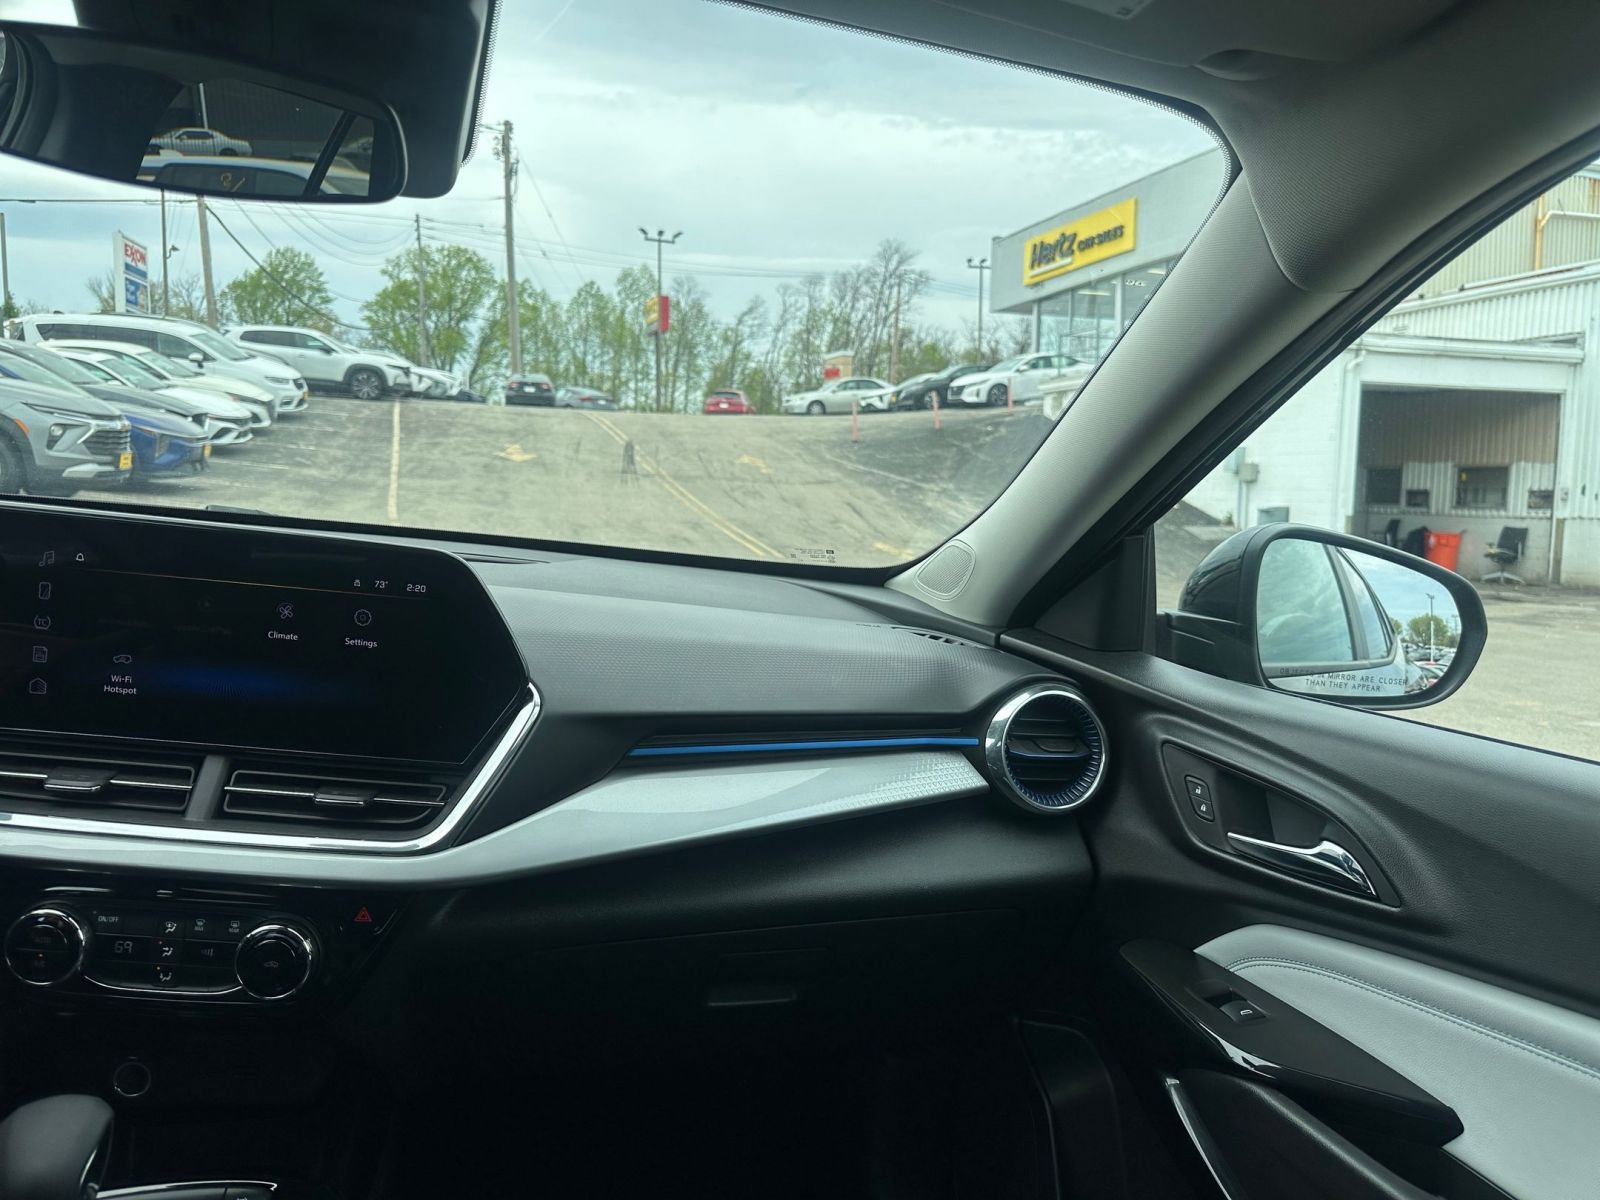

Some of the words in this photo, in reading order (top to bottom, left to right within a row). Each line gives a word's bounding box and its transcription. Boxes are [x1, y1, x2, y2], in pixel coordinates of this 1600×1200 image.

[124, 242, 146, 267] EXXON
[1030, 233, 1077, 270] Hertz
[406, 583, 426, 593] 2:20
[267, 630, 299, 641] Climate
[344, 637, 378, 649] Settings
[110, 674, 132, 684] Wi-Fi
[1305, 678, 1326, 687] THAN
[1328, 680, 1348, 689] THEY
[1351, 684, 1381, 692] APPEAR
[1327, 673, 1356, 682] MIRROR
[1359, 675, 1375, 684] ARE
[1378, 677, 1407, 686] CLOSER
[103, 684, 137, 696] Hotspot
